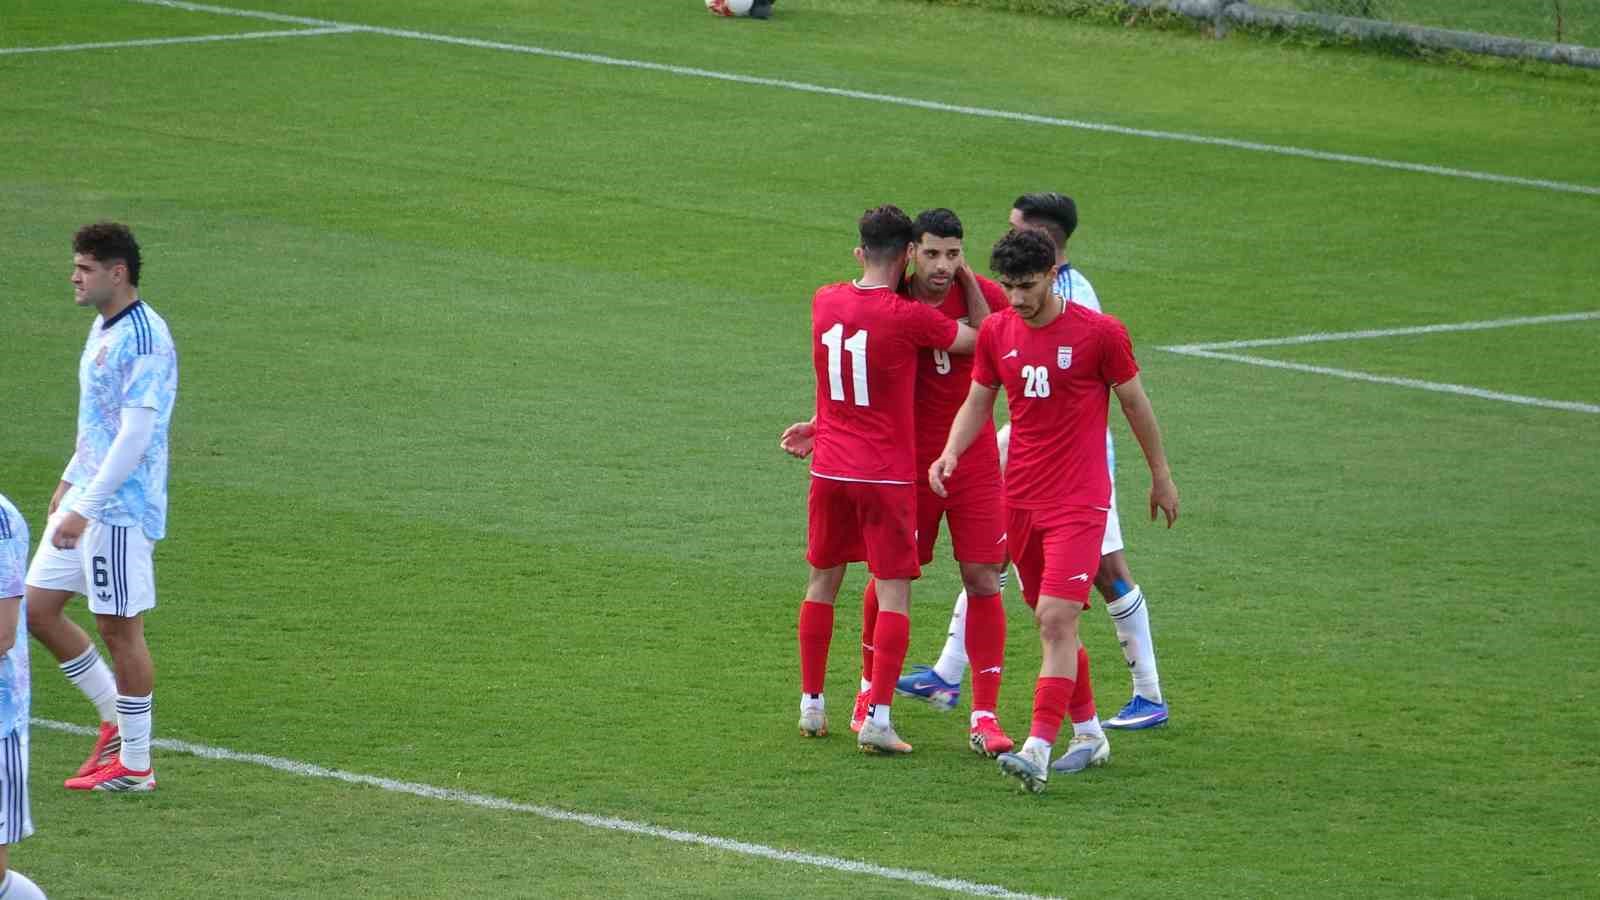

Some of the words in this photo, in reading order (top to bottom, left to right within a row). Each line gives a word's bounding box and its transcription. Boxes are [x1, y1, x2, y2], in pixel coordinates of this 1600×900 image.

[821, 323, 870, 407] 11
[933, 349, 951, 375] 9
[1021, 365, 1050, 398] 28
[92, 556, 108, 587] 6
